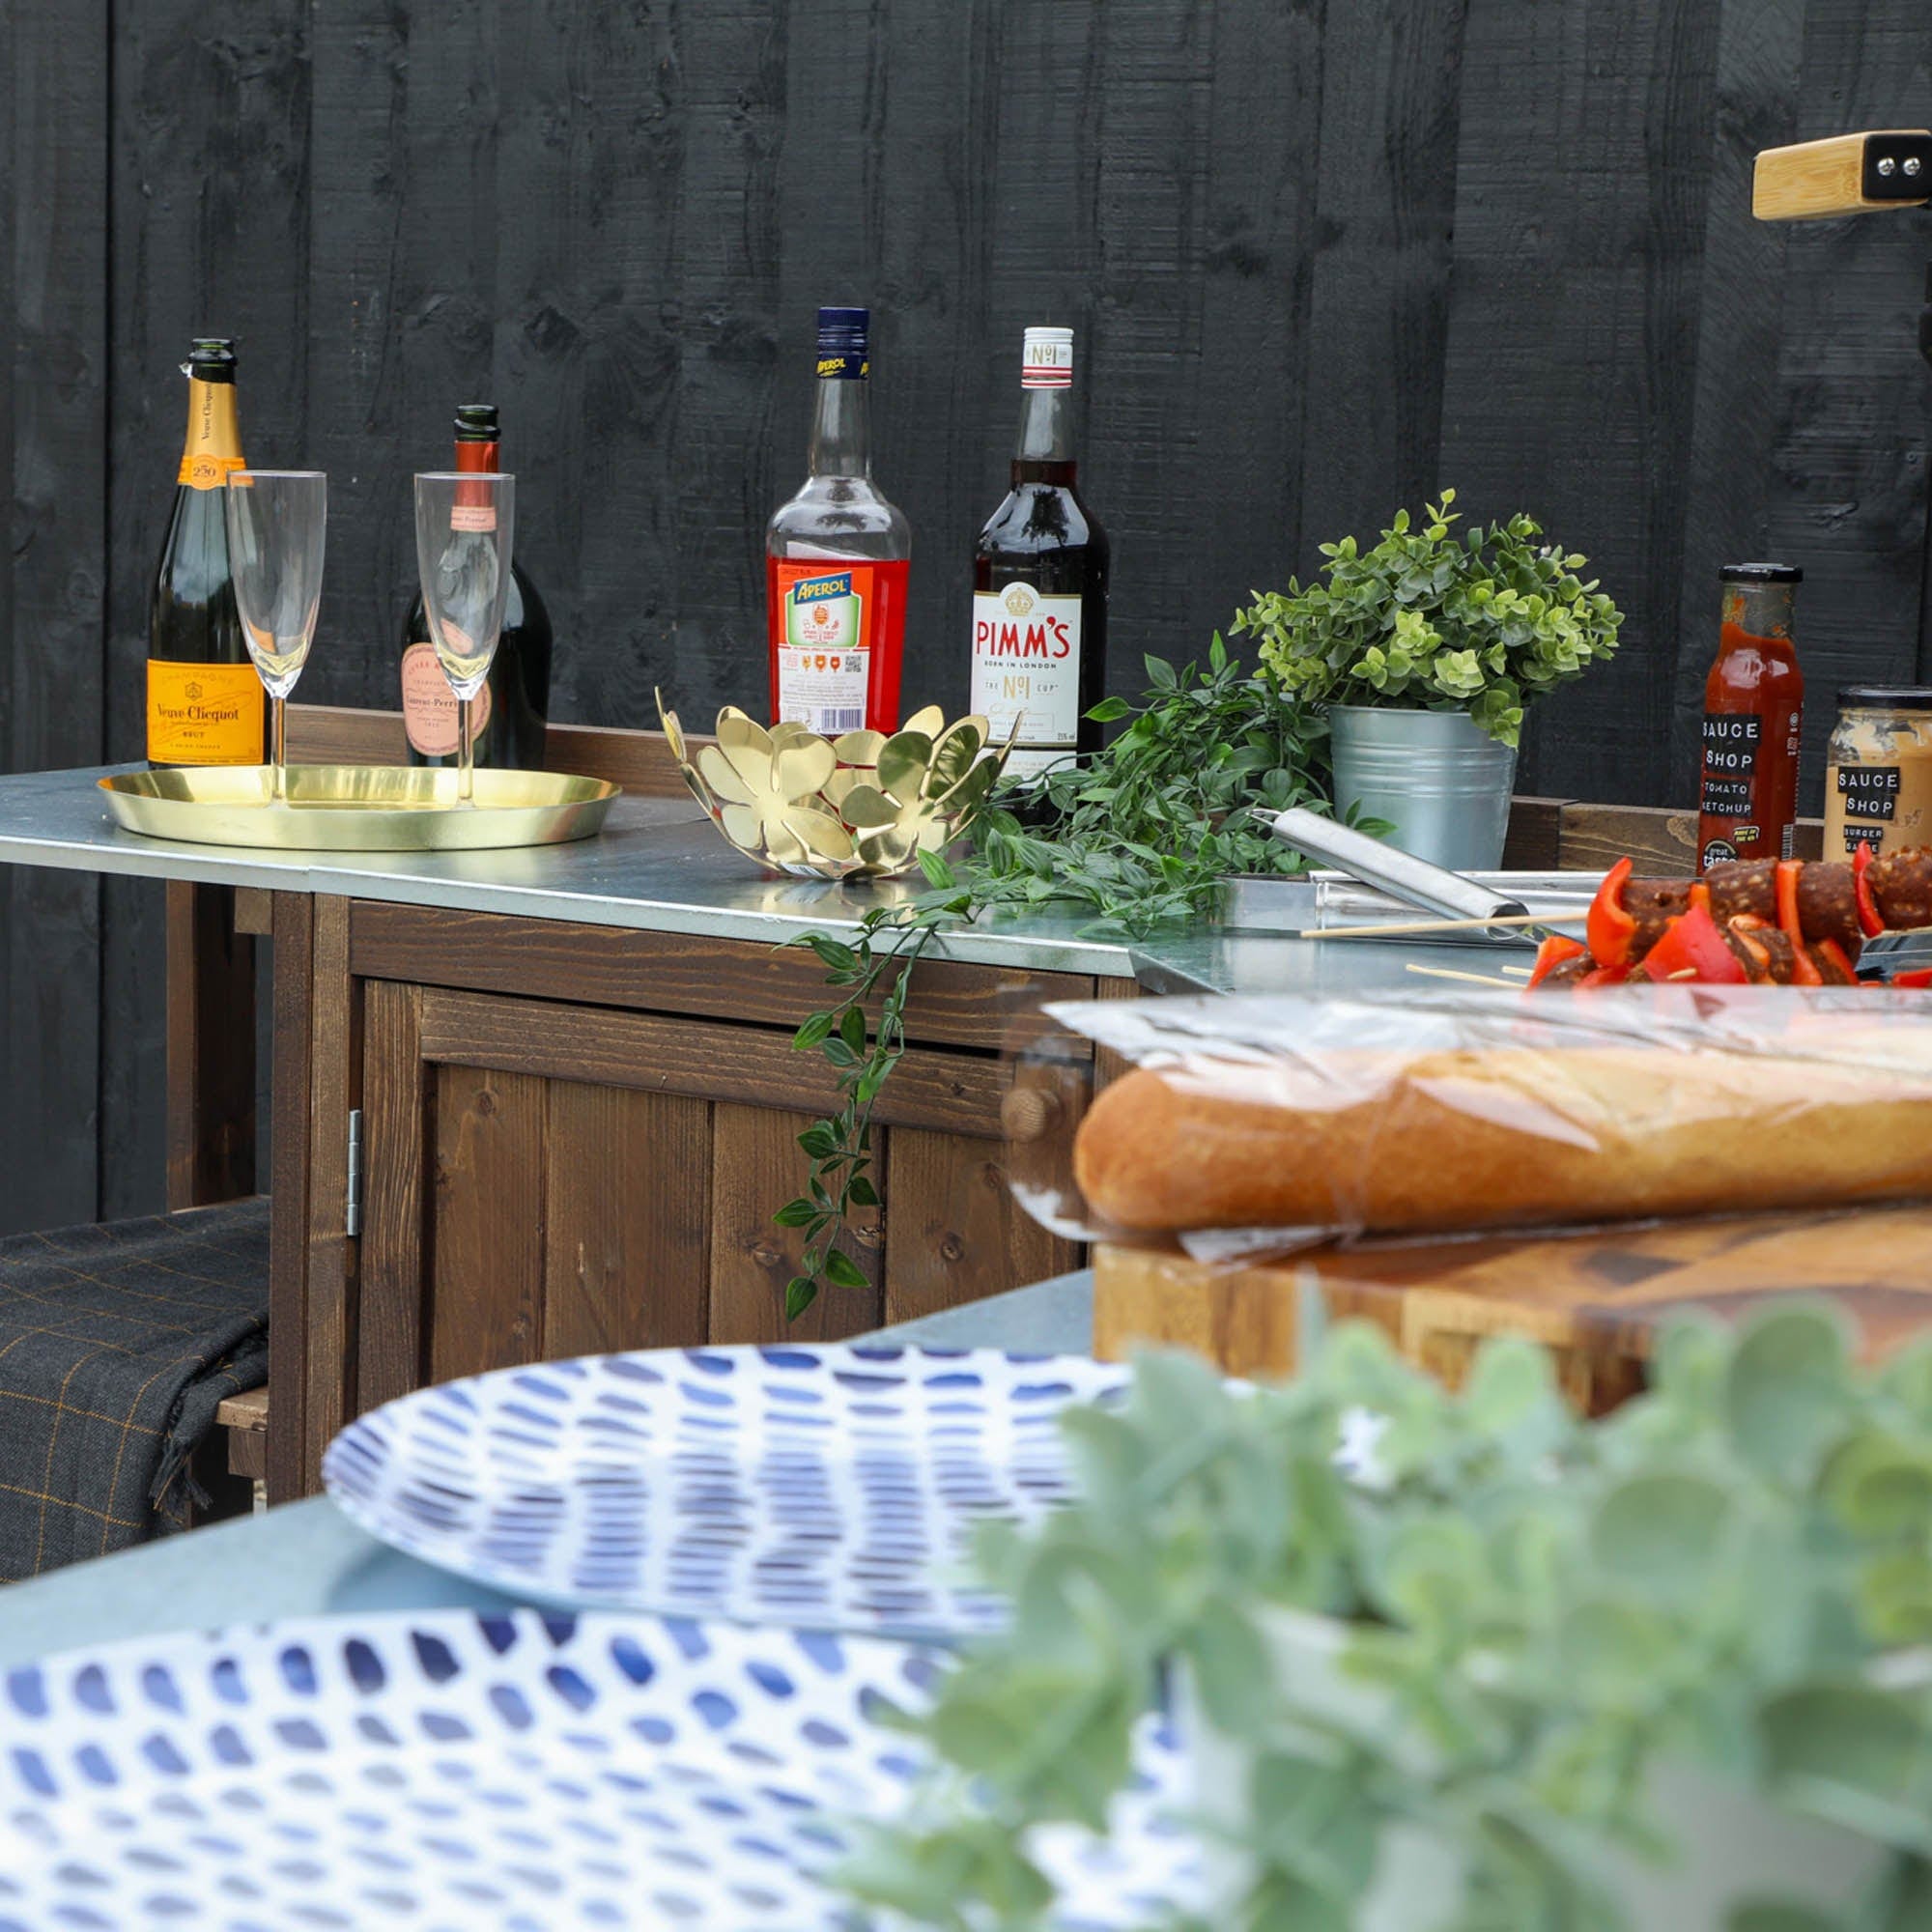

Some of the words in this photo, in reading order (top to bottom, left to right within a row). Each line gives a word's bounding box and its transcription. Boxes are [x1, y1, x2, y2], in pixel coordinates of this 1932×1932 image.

[797, 580, 847, 601] APEROL
[977, 615, 1070, 659] PIMM'S
[407, 697, 458, 708] Laurent-Perri
[157, 702, 185, 719] Veuve
[187, 705, 239, 723] Clicquot
[1702, 722, 1758, 739] SAUCE
[1706, 750, 1752, 768] SHOP
[1705, 781, 1747, 795] TOMATO
[1838, 774, 1897, 787] SAUCE
[1847, 798, 1892, 813] SHOP
[1846, 843, 1877, 852] SAE
